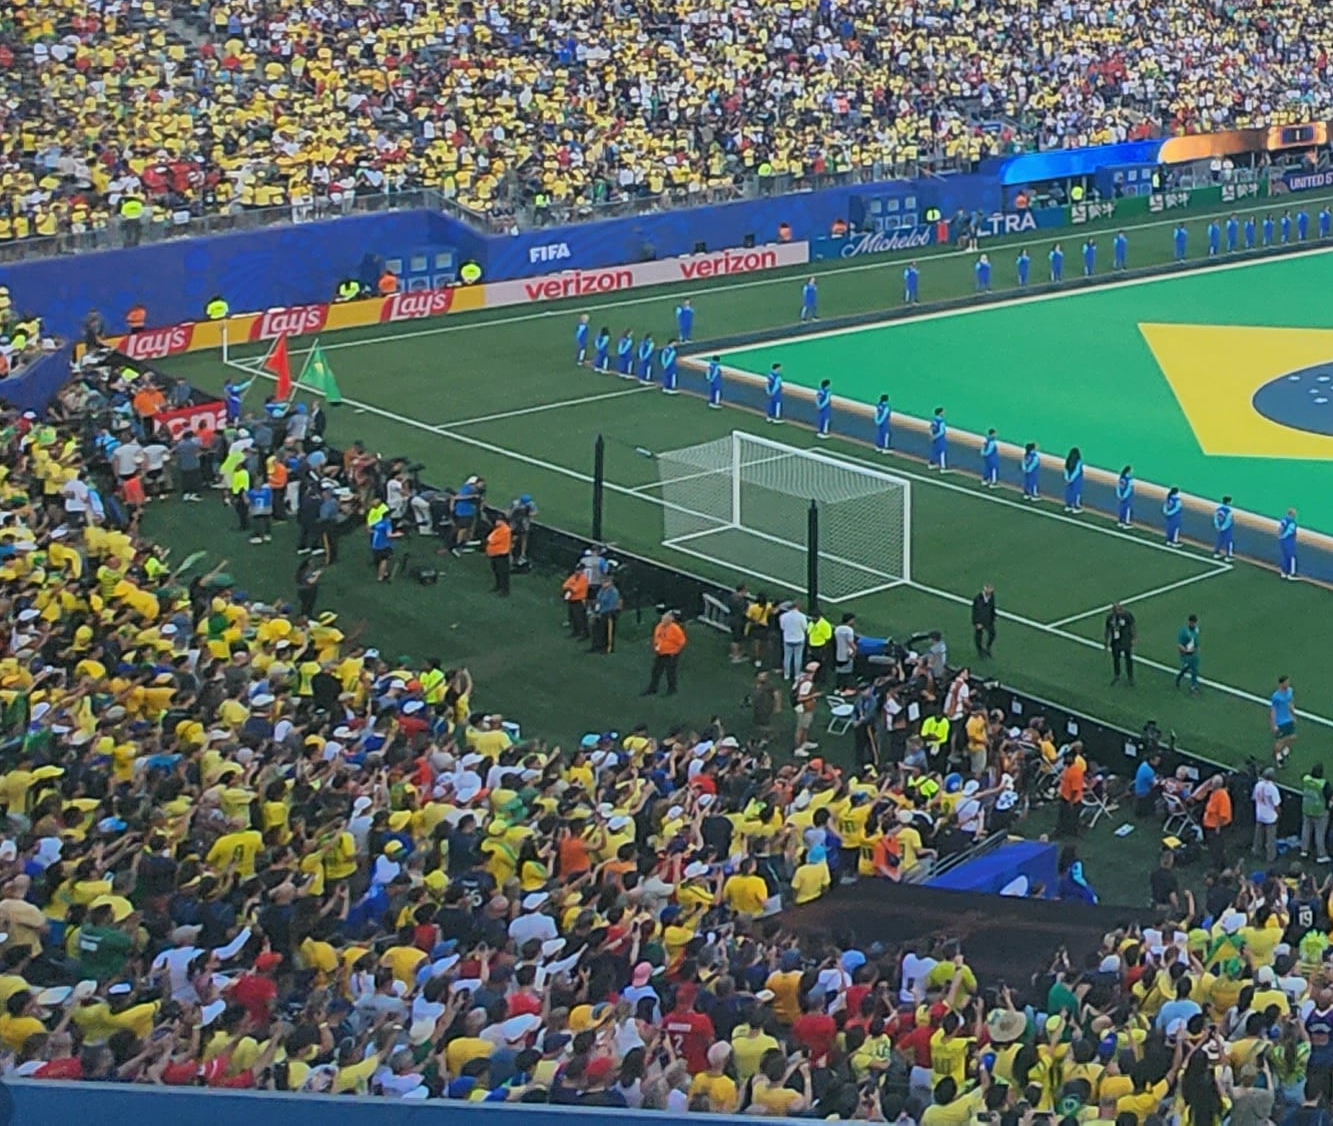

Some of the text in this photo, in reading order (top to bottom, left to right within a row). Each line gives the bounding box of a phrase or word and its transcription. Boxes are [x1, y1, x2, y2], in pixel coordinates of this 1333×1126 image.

[1290, 174, 1324, 190] UNITED
[841, 211, 1037, 258] Michelob LTRA
[529, 242, 571, 263] FIFA
[680, 249, 777, 280] verizon
[525, 269, 634, 301] verizon
[391, 290, 448, 322] Lay's
[260, 305, 323, 340] Lay's
[127, 327, 187, 360] Lay's
[1299, 910, 1313, 928] 19
